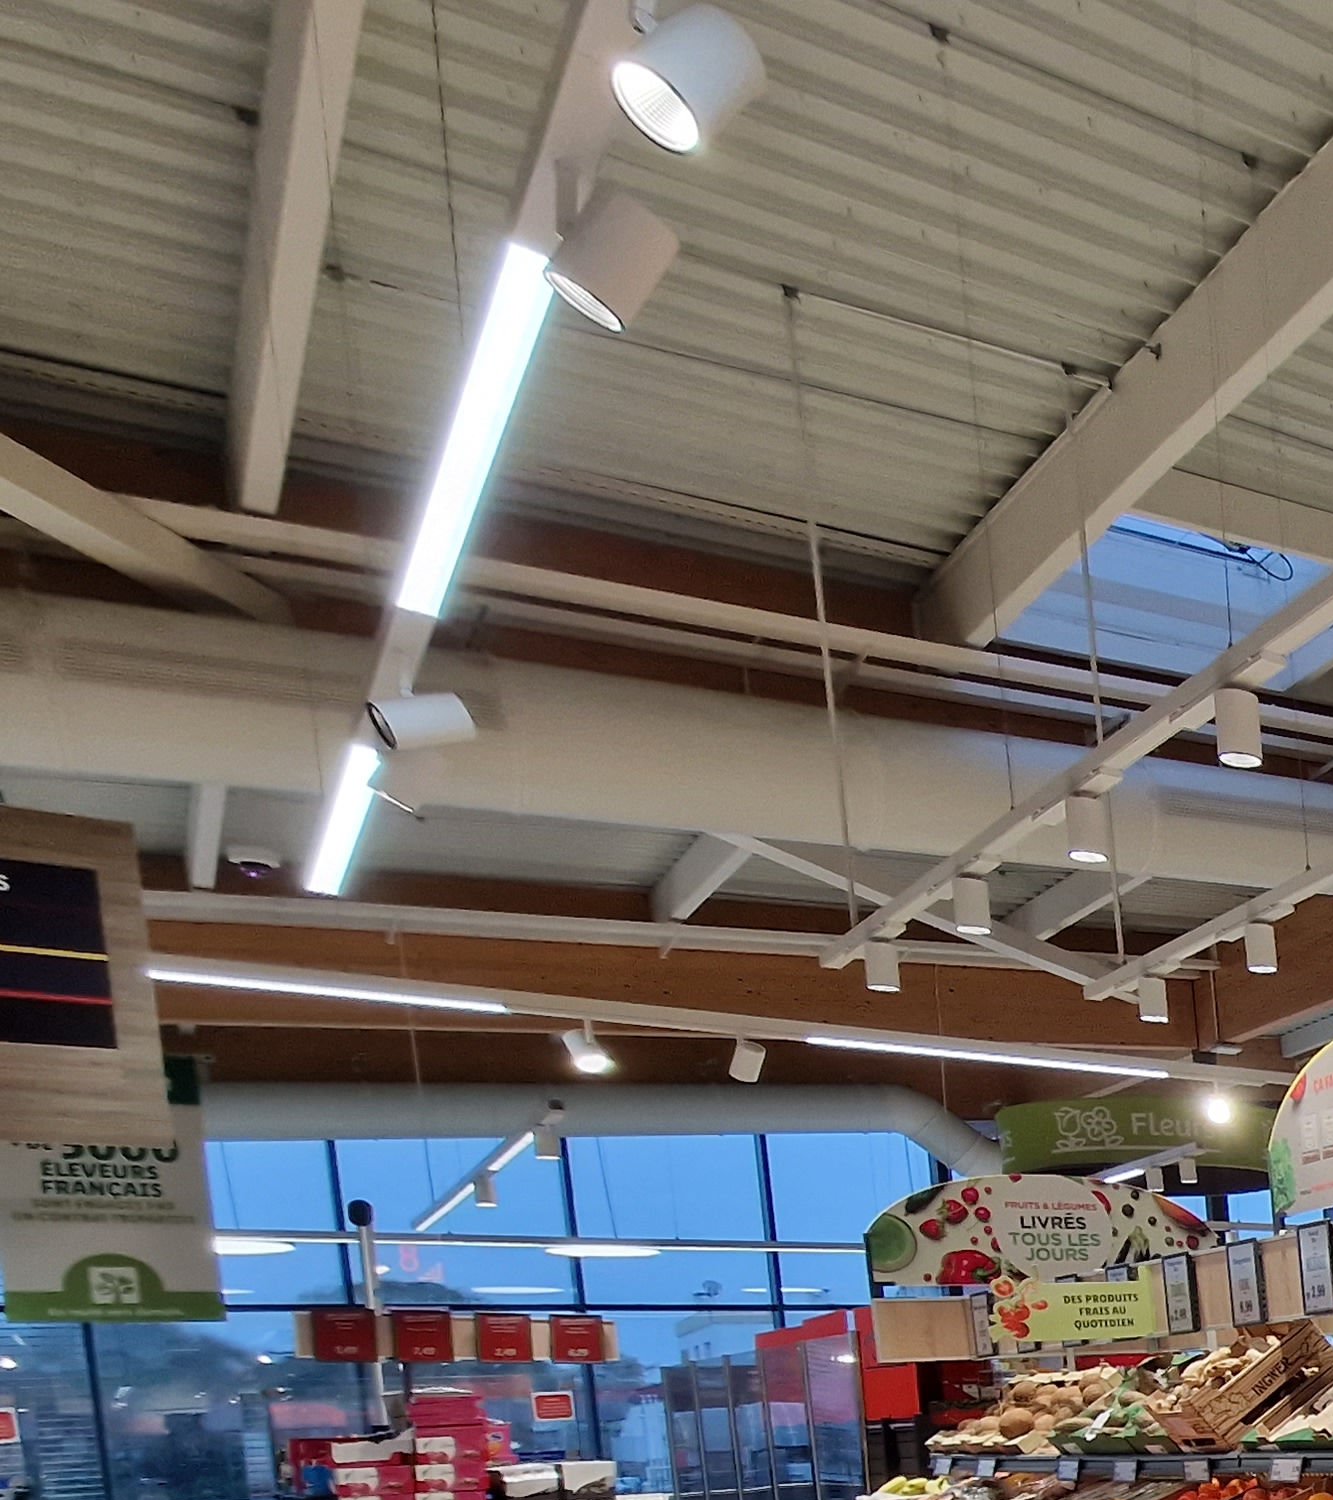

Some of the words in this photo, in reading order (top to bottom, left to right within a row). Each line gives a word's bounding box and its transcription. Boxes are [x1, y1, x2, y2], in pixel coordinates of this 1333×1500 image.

[1313, 1079, 1324, 1095] ÇA
[40, 1178, 163, 1200] FRANÇAIS
[1004, 1200, 1041, 1210] FRUITS
[1051, 1199, 1098, 1212] LÉGUMES
[1020, 1212, 1087, 1230] LIVRÉS
[1008, 1231, 1066, 1247] TOUS
[1067, 1231, 1101, 1247] LES
[1025, 1247, 1089, 1262] JOURS
[1063, 1294, 1084, 1305] DES
[1086, 1292, 1139, 1304] PRODUITS
[1078, 1306, 1110, 1317] FRAIS
[1112, 1305, 1127, 1316] AU
[1073, 1318, 1136, 1331] QUOTIDIEN
[1250, 1355, 1293, 1397] INGWER
